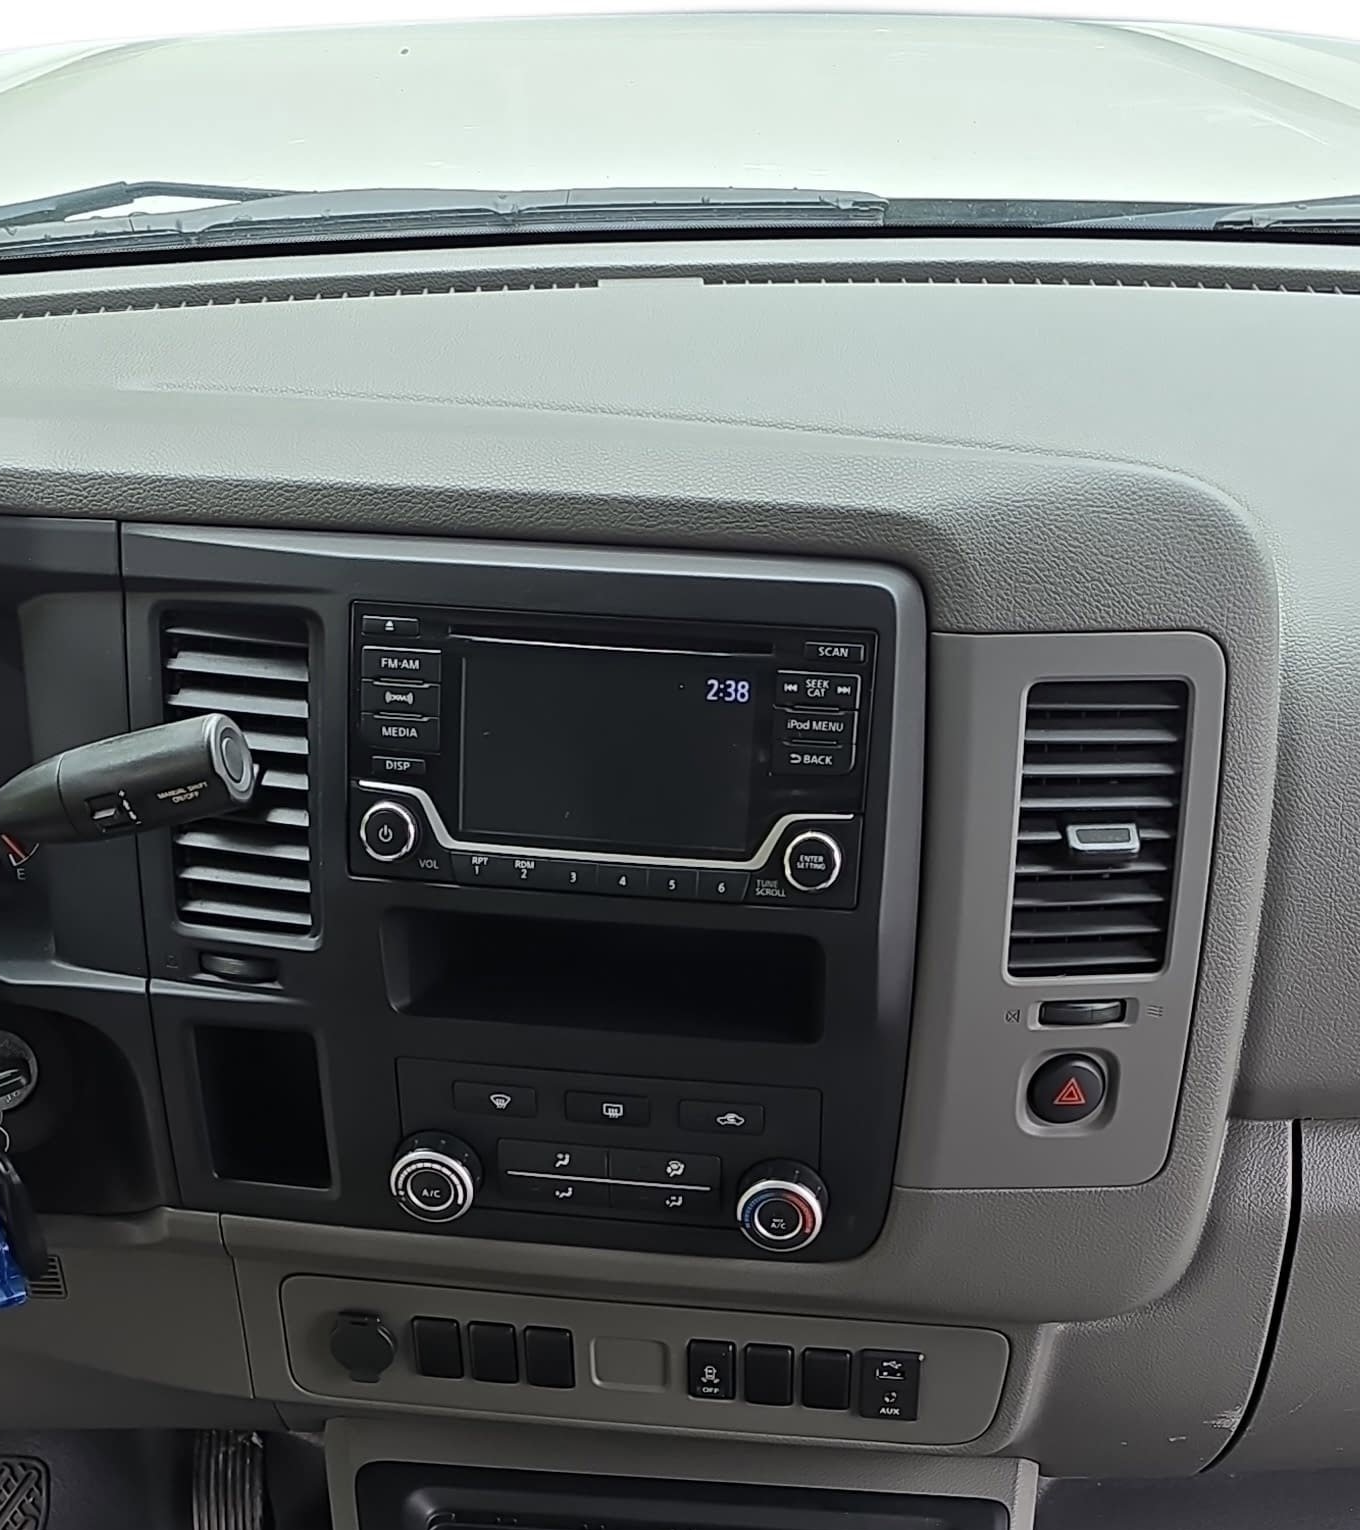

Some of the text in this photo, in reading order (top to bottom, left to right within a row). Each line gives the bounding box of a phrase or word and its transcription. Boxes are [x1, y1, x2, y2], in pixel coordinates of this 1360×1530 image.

[818, 646, 849, 657] SCAN
[805, 679, 830, 689] SEEK
[706, 679, 749, 702] 2:38
[807, 688, 826, 697] CAT
[787, 719, 844, 732] iPod MENU
[381, 726, 418, 738] MEDIA
[803, 754, 833, 766] BACK
[385, 760, 411, 771] DISP
[471, 856, 488, 866] RPT
[800, 855, 824, 863] ENTER
[419, 859, 439, 870] VOL
[514, 860, 535, 869] RDM
[16, 868, 26, 881] E
[474, 866, 480, 875] 1
[520, 869, 528, 879] 2
[569, 872, 577, 883] 3
[618, 875, 627, 887] 4
[668, 879, 677, 891] 5
[717, 882, 726, 894] 6
[756, 880, 778, 888] TUNE
[755, 888, 786, 897] SCROLL
[421, 1188, 441, 1198] A/C
[770, 1222, 786, 1230] A/C
[702, 1386, 720, 1394] OFF
[879, 1407, 900, 1416] AUX
